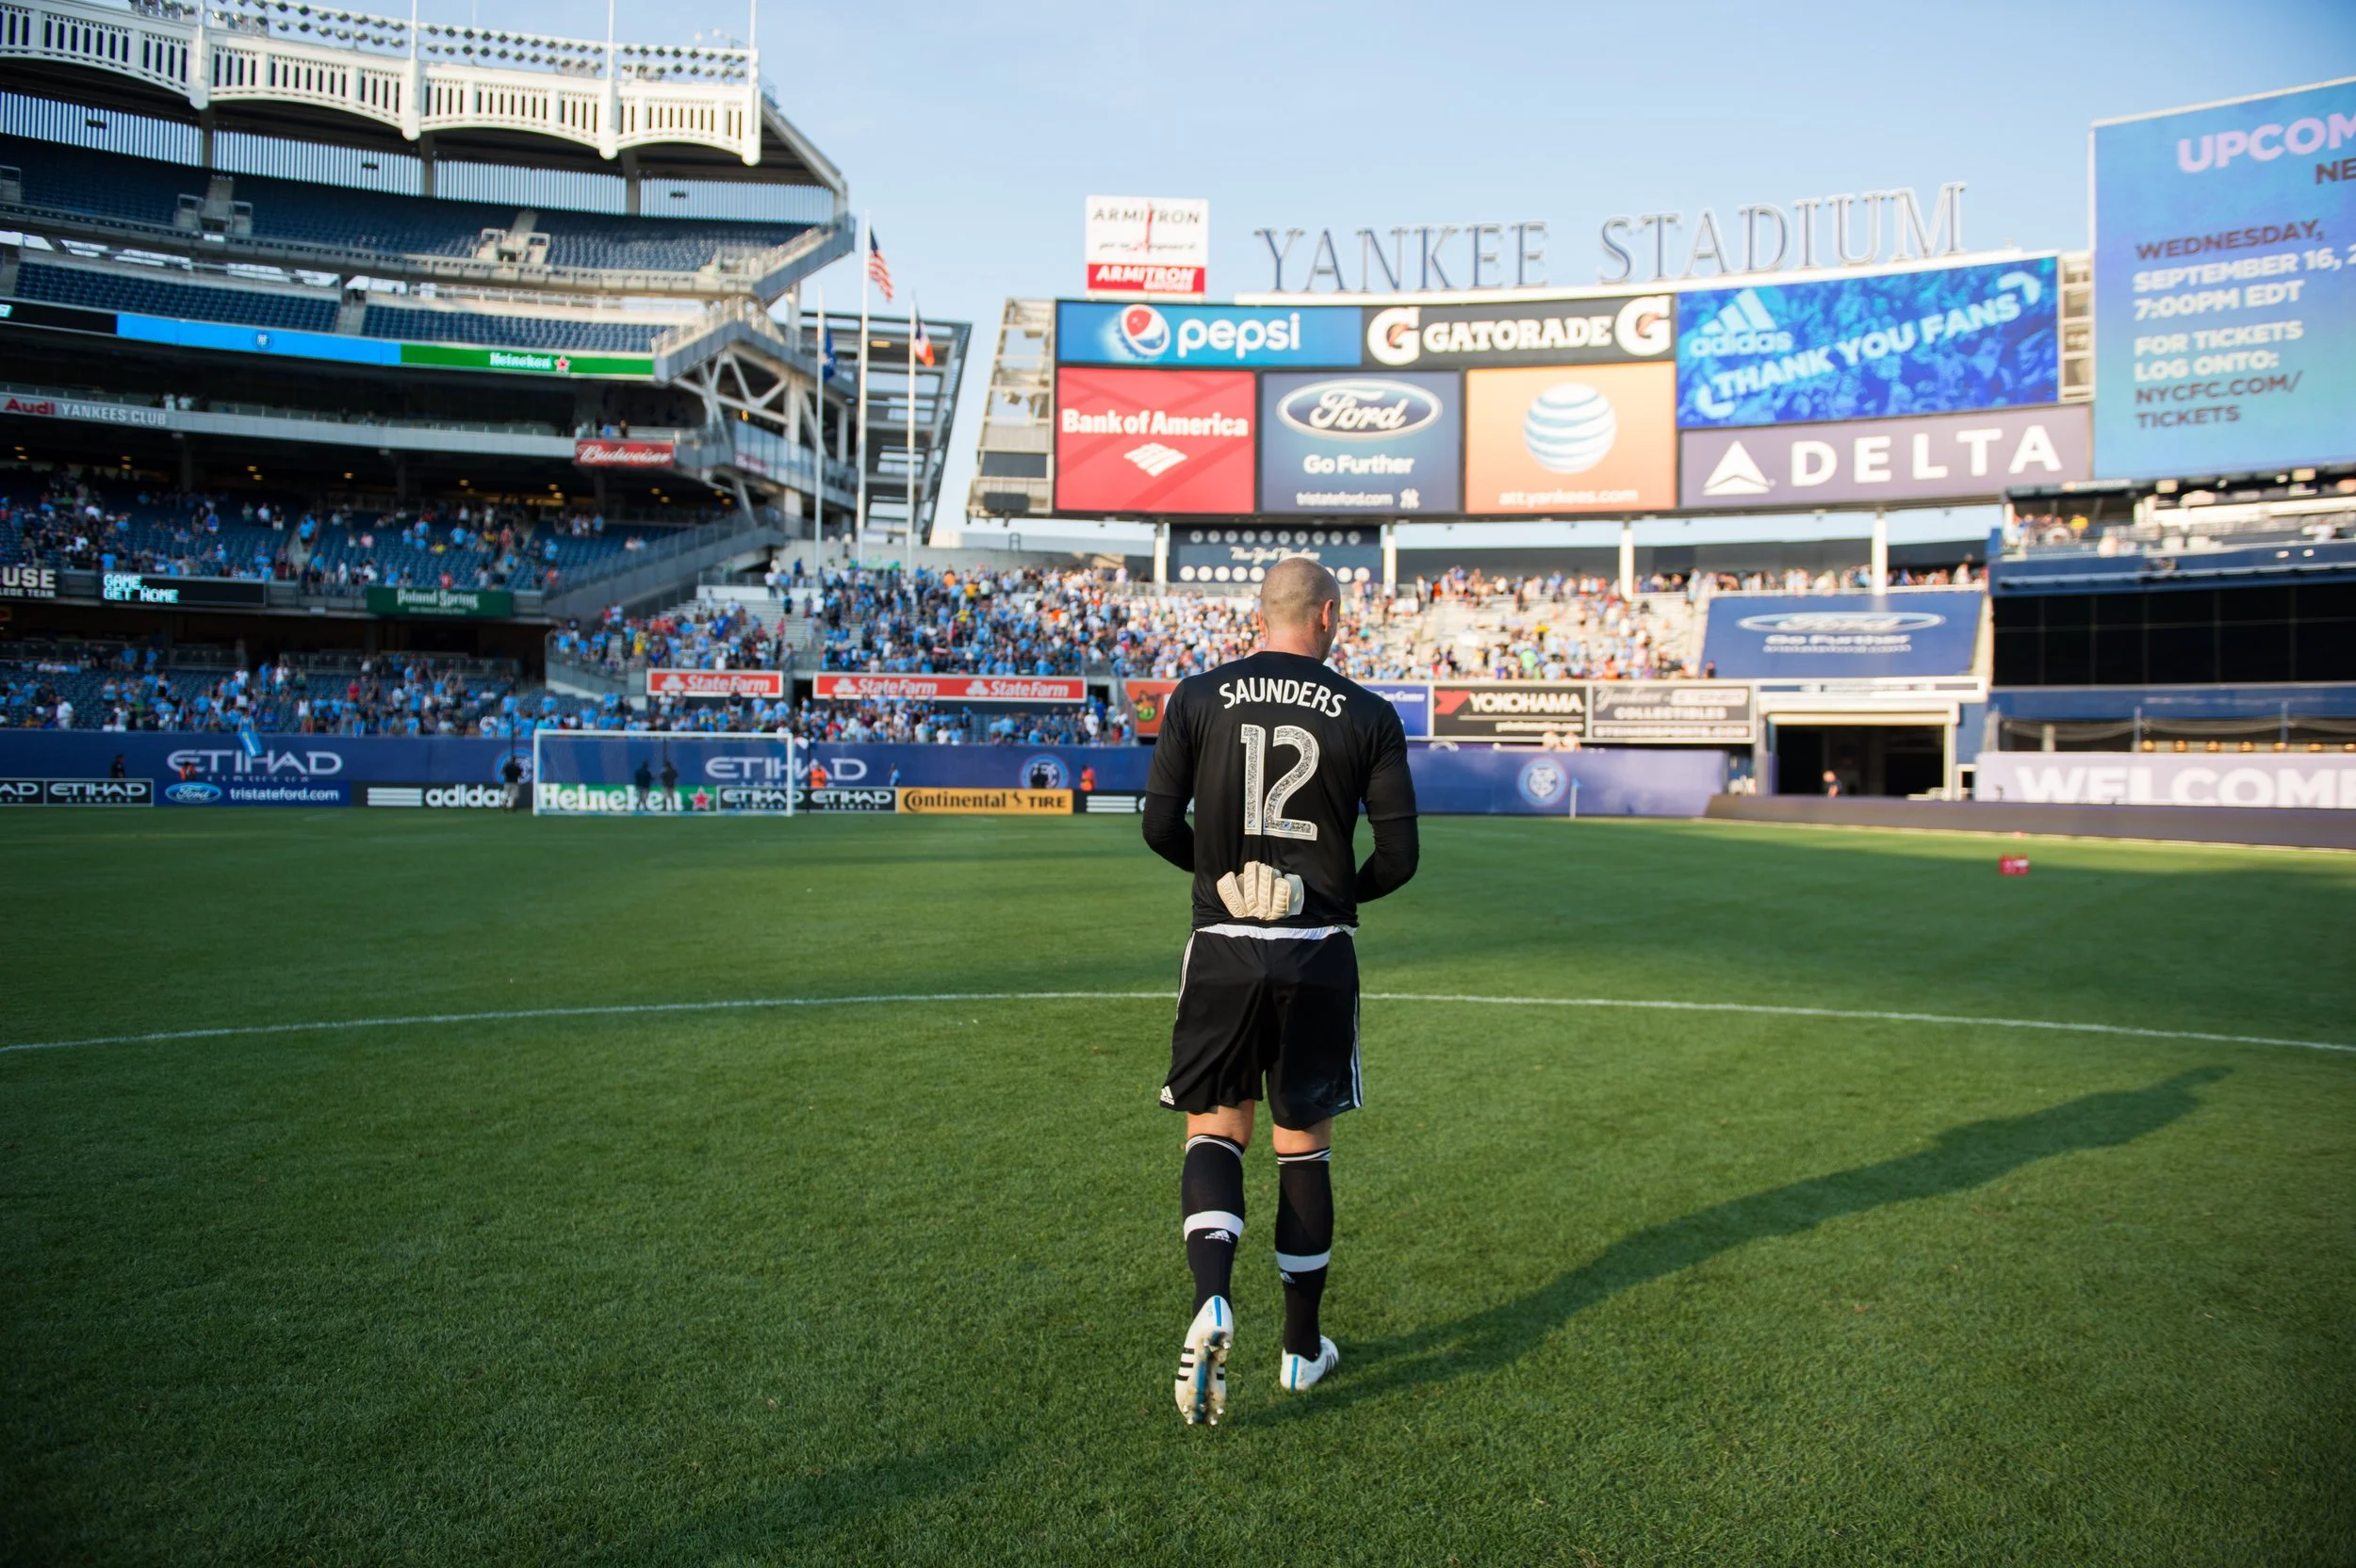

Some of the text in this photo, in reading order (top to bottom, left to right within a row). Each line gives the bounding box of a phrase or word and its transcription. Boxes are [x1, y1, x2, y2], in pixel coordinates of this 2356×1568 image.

[1252, 181, 1968, 294] YANKEE STADIUM
[2135, 219, 2325, 260] WEDNESDAY,
[1095, 265, 1196, 283] ARMITRON
[2133, 253, 2299, 292] SEPTEMBER
[2303, 247, 2342, 271] 16,
[2133, 279, 2305, 321] 7:00PM EDT
[1178, 312, 1302, 360] pepsi
[1423, 315, 1614, 353] GATORADE
[1690, 330, 1793, 357] adidas
[1711, 292, 2023, 400] THANK YOU FANS
[2134, 320, 2303, 357] FOR TICKETS
[2134, 350, 2281, 382] LOG ONTO:
[5, 397, 167, 427] Audi YANKEES CLUB
[1308, 379, 1410, 430] Ford
[2135, 405, 2241, 429] TICKETS
[1061, 408, 1249, 436] Bank of America
[1303, 453, 1415, 475] Go Further
[1791, 425, 2064, 488] DELTA
[103, 587, 134, 601] GET
[1219, 677, 1347, 718] SAUNDERS
[1469, 693, 1585, 712] YOKOHAMA
[166, 749, 344, 775] ETIHAD
[50, 783, 147, 796] ETIHAD
[229, 787, 340, 801] tristateford.com
[810, 791, 892, 804] ETIHAD
[1240, 724, 1319, 841] 12
[904, 790, 1067, 813] Continental TIRE
